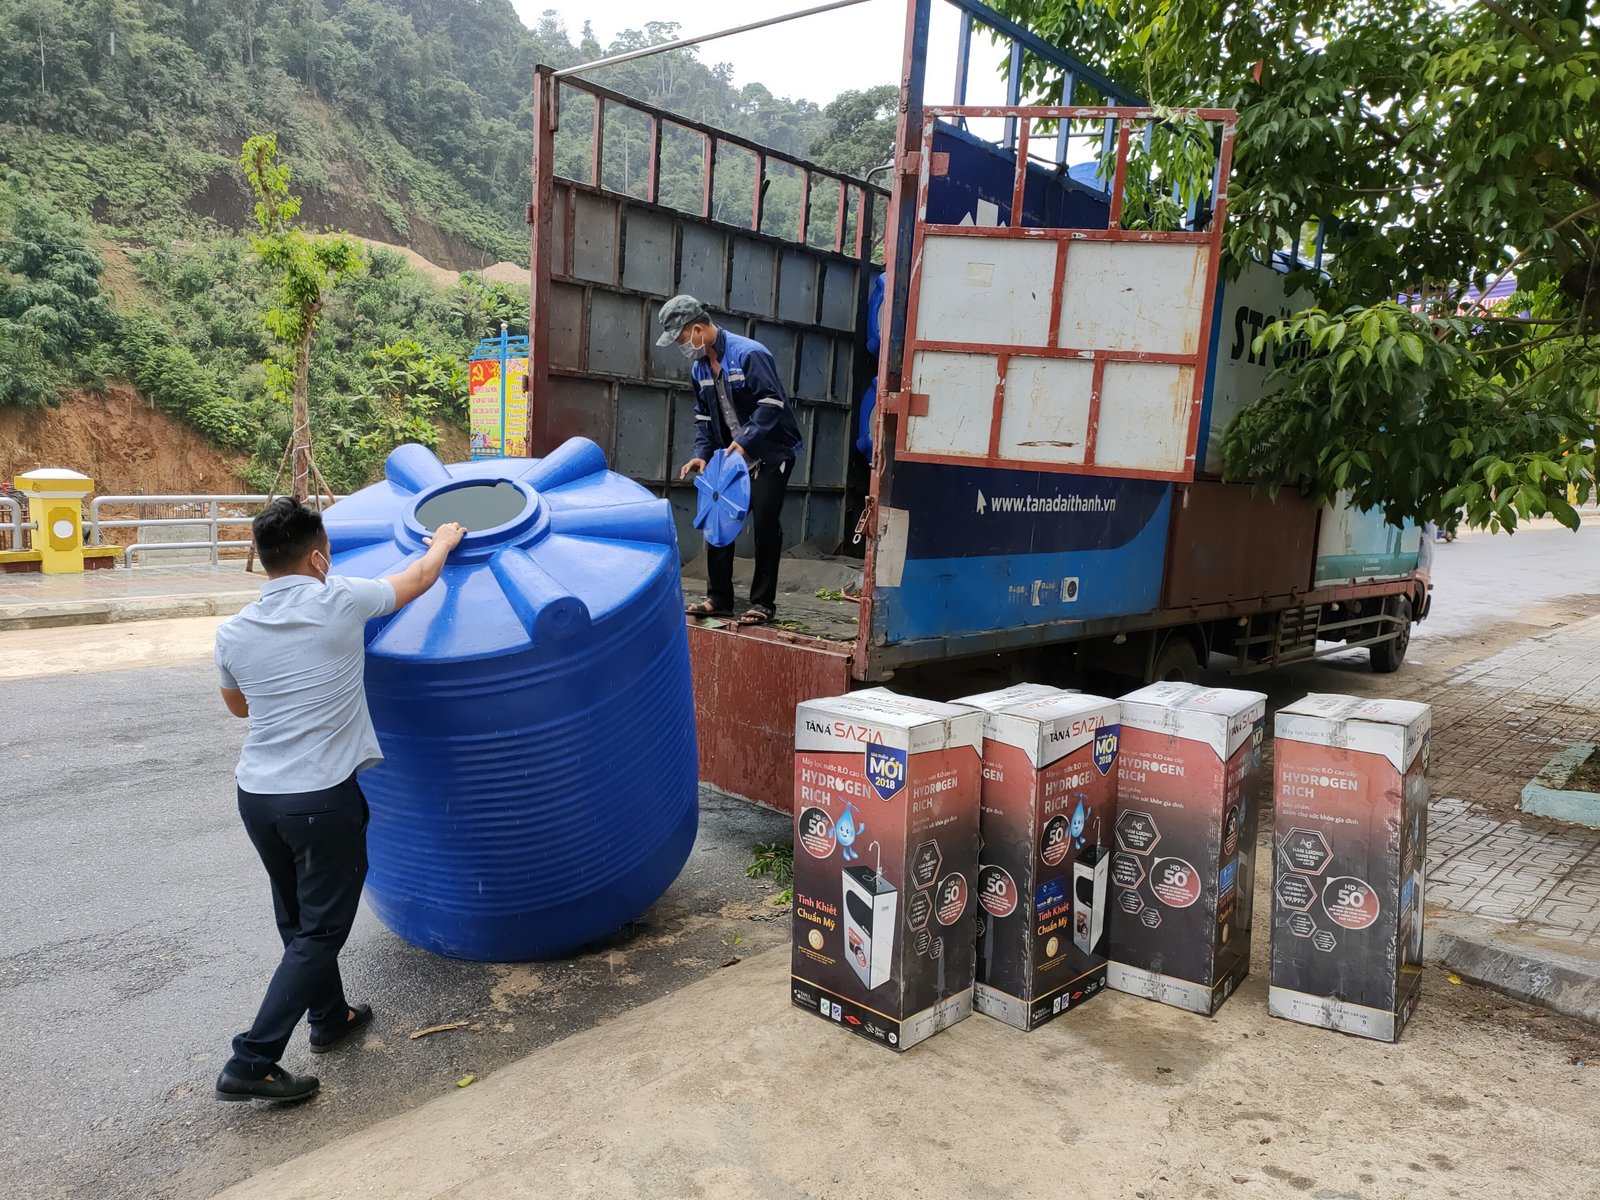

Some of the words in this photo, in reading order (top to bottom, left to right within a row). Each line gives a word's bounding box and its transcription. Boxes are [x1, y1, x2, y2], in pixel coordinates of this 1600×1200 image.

[991, 494, 1116, 512] www.tanadaithanh.vn
[1096, 733, 1118, 757] MỚI
[869, 757, 903, 781] MỚI
[1117, 768, 1146, 783] RICH
[1118, 756, 1184, 777] HYDROGEN
[801, 768, 872, 799] HYDROGEN
[875, 776, 895, 790] 2018
[913, 777, 958, 799] HYDROGEN
[1045, 771, 1096, 796] HYDROGEN
[1282, 771, 1358, 791] HYDROGEN
[801, 786, 831, 806] RICH
[1282, 784, 1315, 798] RICH
[912, 797, 933, 813] RICH
[1044, 795, 1069, 814] RICH
[808, 818, 827, 838] 50
[1048, 826, 1064, 845] 50
[1170, 863, 1181, 871] HD
[986, 877, 1007, 896] 50
[1163, 869, 1188, 887] 50
[1344, 883, 1356, 891] HD
[943, 885, 960, 904] 50
[1337, 889, 1365, 908] 50
